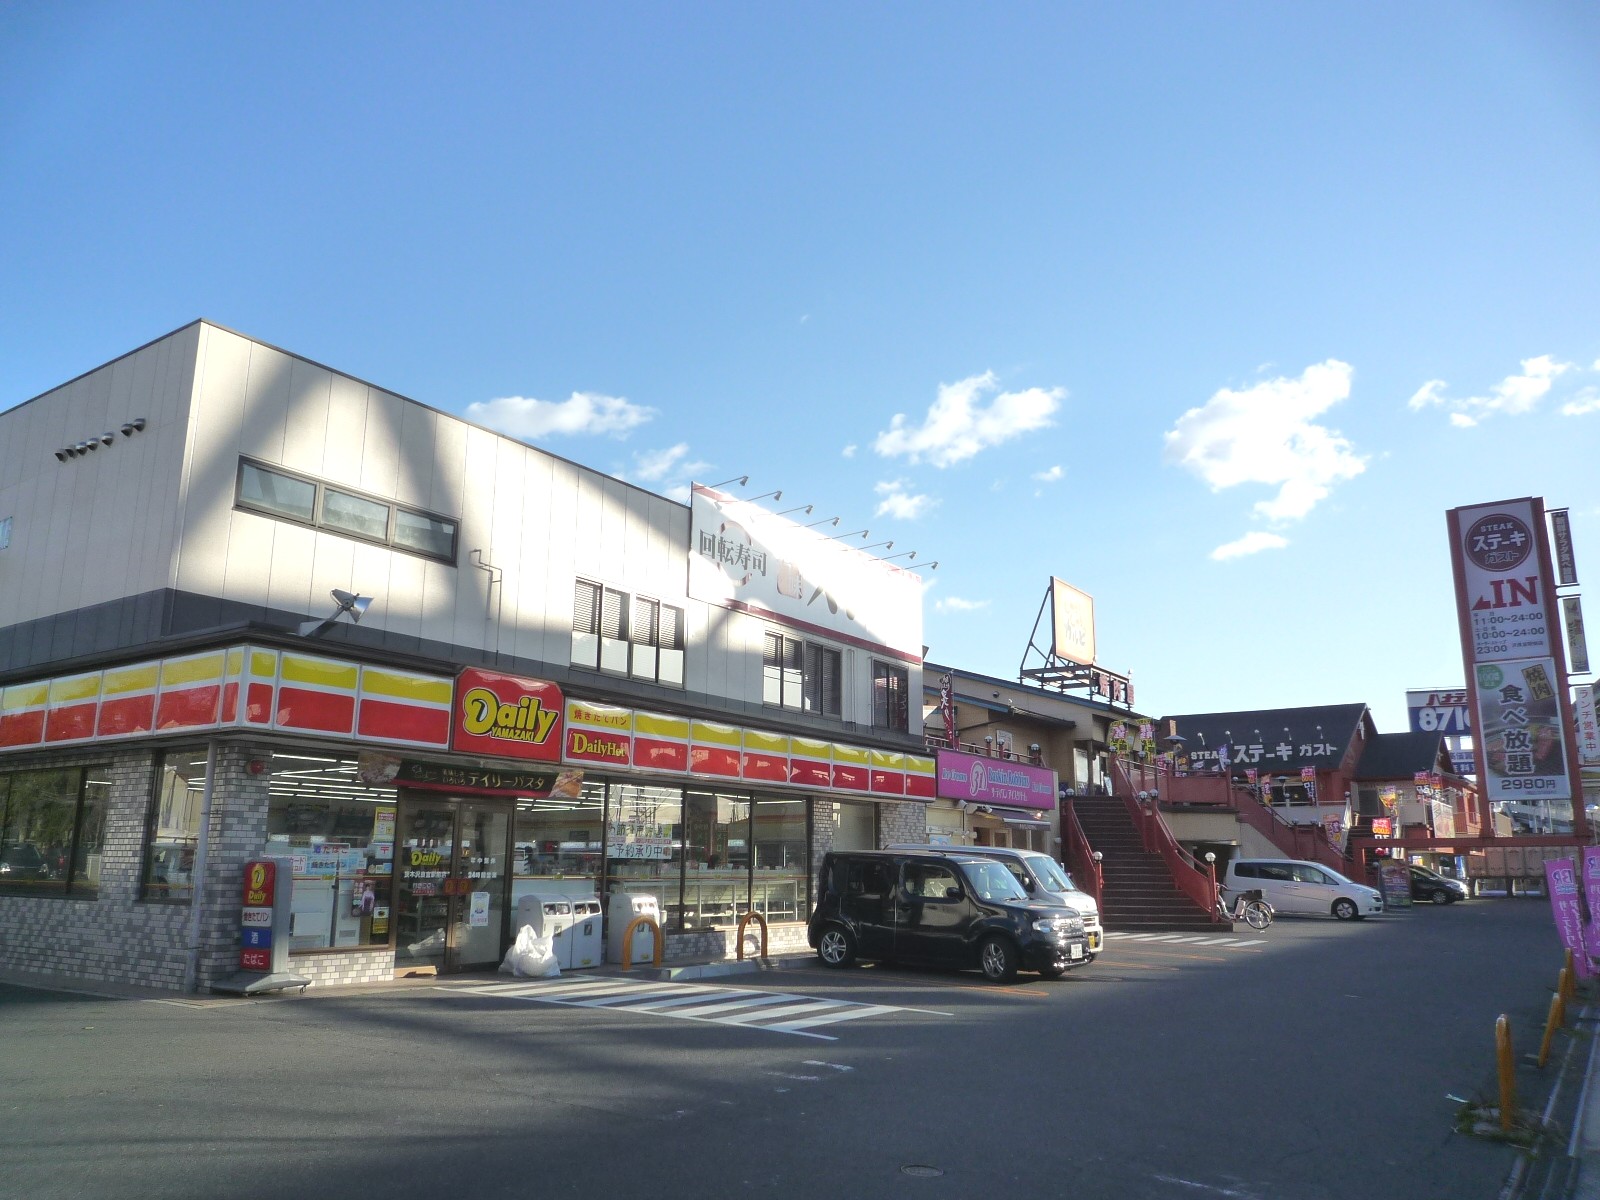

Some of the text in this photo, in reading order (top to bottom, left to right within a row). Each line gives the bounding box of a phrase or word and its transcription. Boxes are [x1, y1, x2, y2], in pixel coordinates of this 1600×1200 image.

[1480, 522, 1514, 533] STEAK
[1473, 531, 1526, 552] ステーキ
[699, 529, 768, 577] 回転寿司
[1485, 551, 1520, 565] ガスト
[1489, 575, 1538, 609] IN
[1476, 644, 1508, 655] 23:00
[463, 687, 559, 744] Daily
[573, 708, 627, 726] 焼きたてパン
[1579, 689, 1597, 751] ランチ営業中
[491, 726, 535, 741] YAMAZAKI
[1499, 684, 1534, 775] 食べ放題
[1190, 751, 1222, 761] STEA
[1233, 742, 1338, 764] ステーキ ガスト
[1501, 778, 1556, 790] 2980円
[411, 850, 442, 866] Daily
[248, 890, 267, 902] Daily
[243, 911, 270, 922] 焼きたてパン
[243, 953, 264, 966] たばこ
